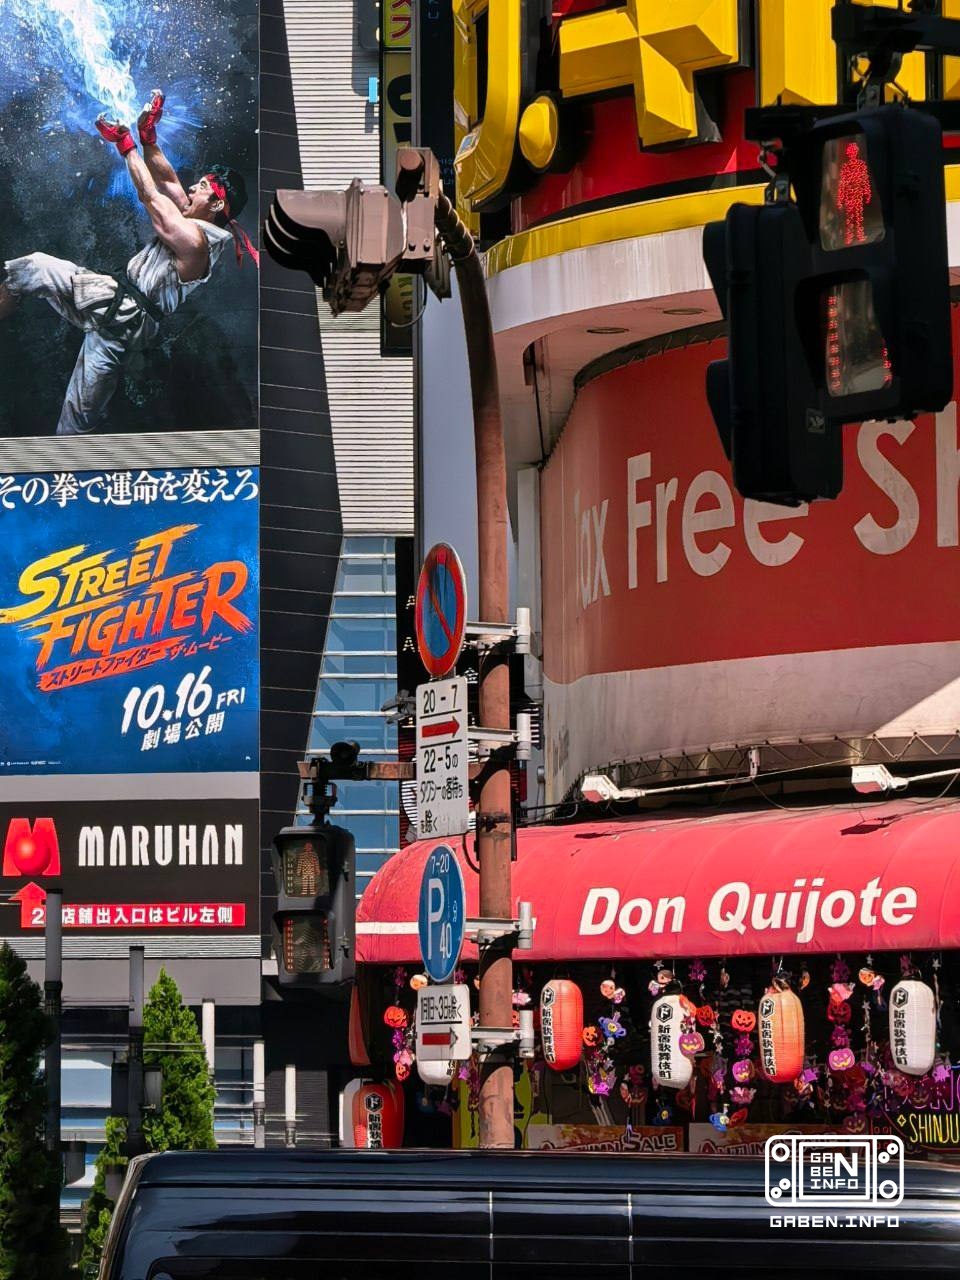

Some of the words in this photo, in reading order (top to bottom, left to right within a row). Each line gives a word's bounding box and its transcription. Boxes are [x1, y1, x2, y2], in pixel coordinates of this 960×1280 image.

[626, 451, 809, 589] Free
[18, 561, 254, 672] FIGHTER
[121, 665, 213, 737] 10.16
[216, 686, 246, 710] FRI
[140, 711, 225, 751] 劇場公開
[78, 824, 244, 867] MARUHAN
[31, 906, 234, 926] 2店舗出入口はビル左側
[578, 887, 686, 936] Don
[708, 876, 918, 944] Quijote
[656, 1023, 672, 1081] 新宿歌舞伎町
